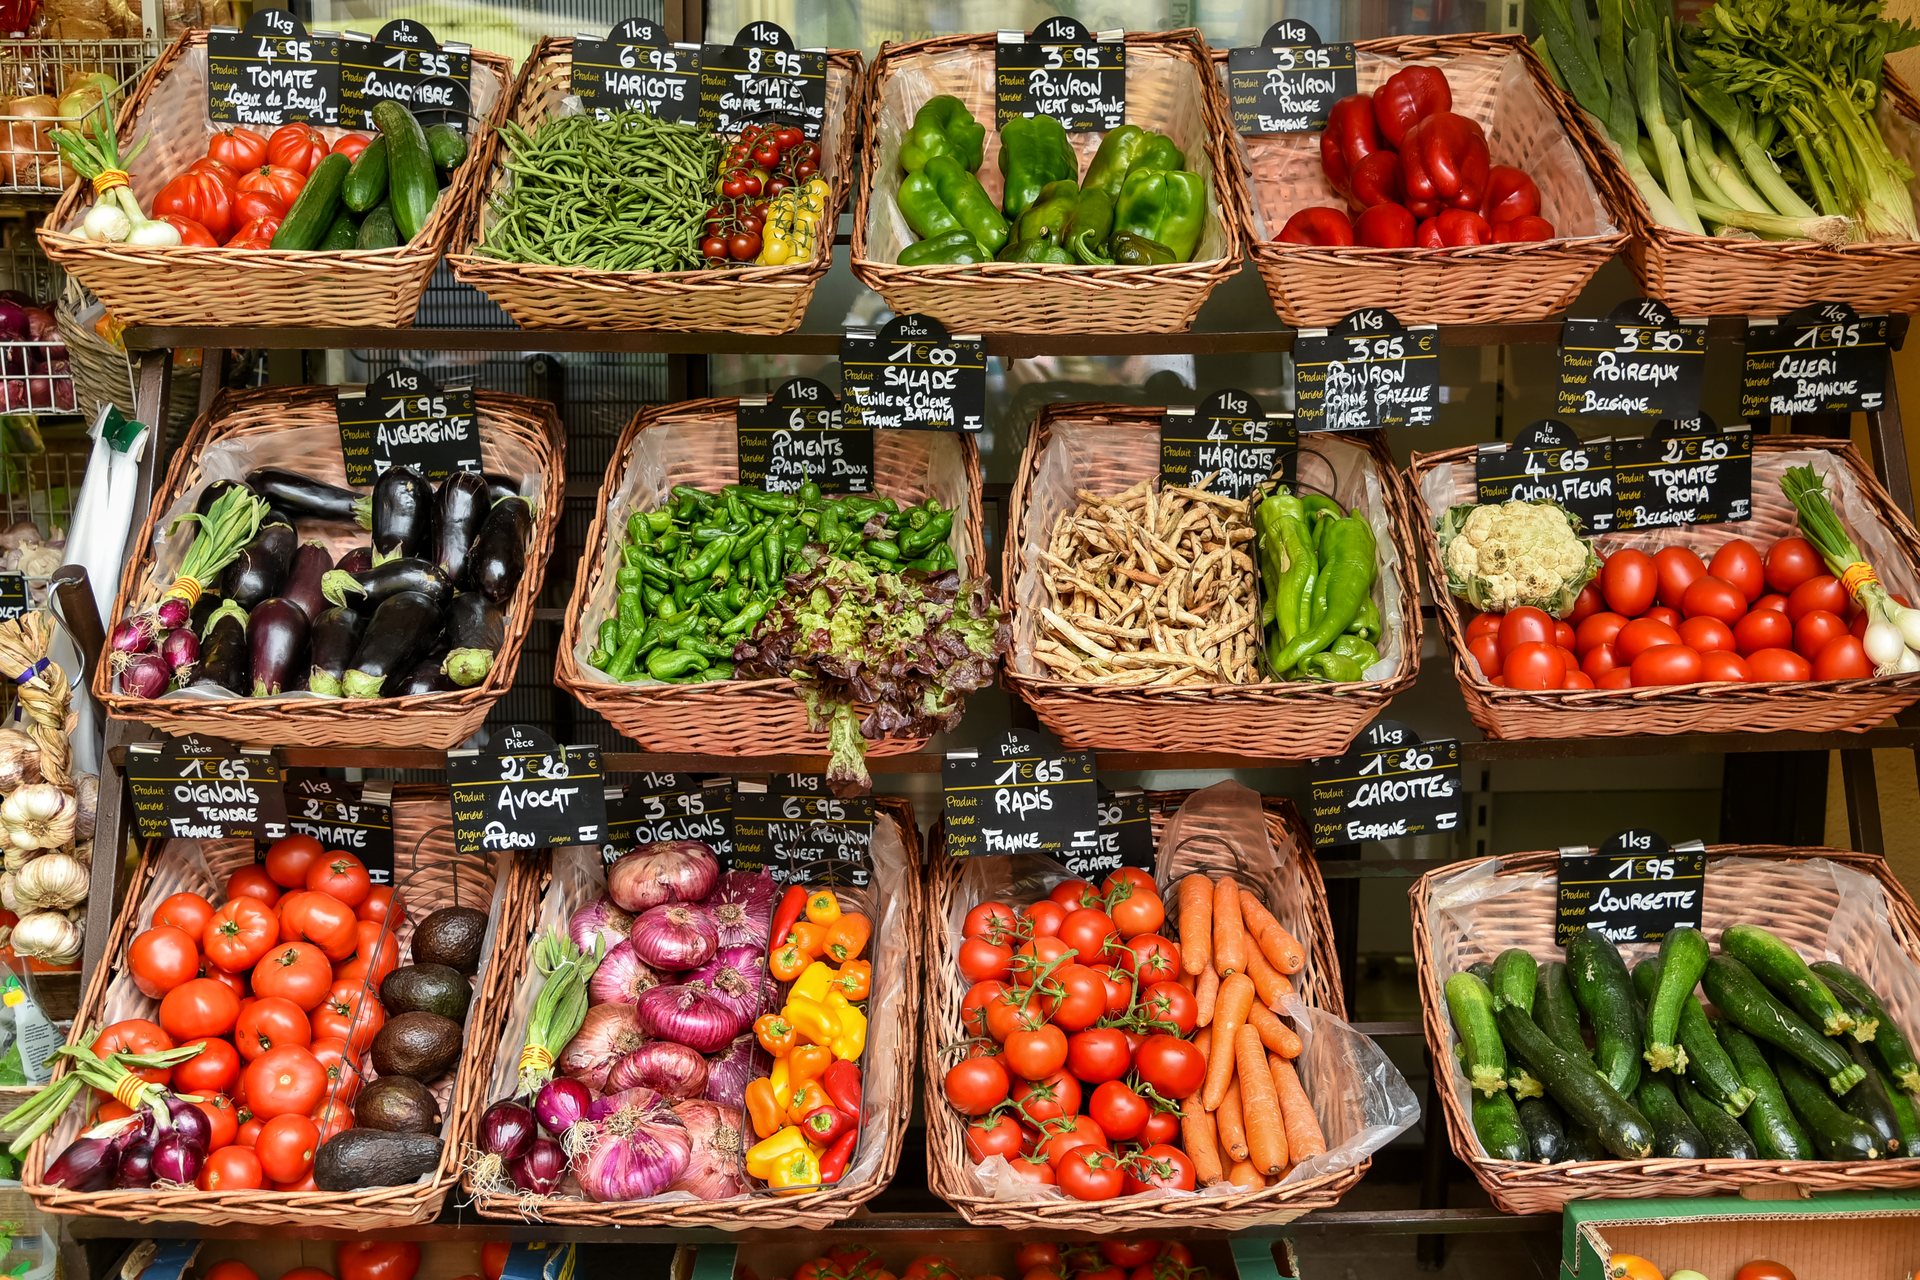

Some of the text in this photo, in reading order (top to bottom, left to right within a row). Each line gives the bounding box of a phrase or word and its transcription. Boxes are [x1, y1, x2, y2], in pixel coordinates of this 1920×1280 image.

[265, 11, 294, 35] 1kg
[401, 20, 410, 32] la
[622, 20, 652, 40] 1kg
[1046, 20, 1075, 40] 1kg
[1278, 22, 1306, 42] 1kg
[393, 30, 418, 43] Pièce
[751, 24, 779, 45] 1kg
[246, 66, 318, 89] TOMATE
[605, 71, 687, 101] HARICOTS
[734, 74, 808, 98] TOMATE
[1029, 69, 1102, 97] POIVRON
[1263, 69, 1336, 96] POIVRON
[360, 71, 454, 106] CONCOMBRE
[1036, 98, 1069, 114] VERT
[1085, 95, 1125, 118] JAUNE
[1279, 95, 1321, 113] ROUGE
[1257, 114, 1309, 132] ESPAGNE
[900, 325, 928, 336] Pièce
[909, 316, 918, 326] la
[1349, 310, 1383, 331] 1Kg
[1593, 351, 1680, 388] POIREAUX
[1773, 350, 1837, 379] CELERI
[387, 371, 418, 390] 1kg
[788, 381, 818, 400] 1kg
[883, 365, 960, 395] SALADE
[1794, 379, 1858, 402] BRANCHE
[1218, 392, 1248, 414] 1kg
[1580, 390, 1649, 415] BELGIQUE
[1769, 395, 1818, 416] FRANCE
[861, 410, 902, 429] FRANCE
[903, 406, 955, 426] BATAVIA
[376, 416, 470, 457] AUBERGINE
[1545, 421, 1553, 433] la
[772, 430, 844, 457] PIMENTS
[1534, 431, 1560, 445] Pièce
[832, 458, 868, 476] DOUX
[1198, 443, 1276, 470] HARICOTS
[1648, 464, 1719, 487] TOMATE
[1666, 485, 1709, 504] ROMA
[1633, 505, 1696, 528] BELGIQUE
[188, 736, 199, 745] la
[511, 727, 522, 738] la
[1008, 732, 1018, 743] la
[1369, 724, 1403, 744] 1kg
[182, 744, 213, 754] Pièce
[505, 738, 535, 749] Pièce
[1000, 743, 1030, 756] Pièce
[300, 780, 332, 794] 1kg
[643, 772, 676, 789] 1kg
[787, 773, 818, 791] 1kg
[1347, 774, 1454, 808] CAROTTES
[174, 780, 260, 804] OIGNONS
[497, 784, 579, 820] AVOCAT
[197, 806, 258, 822] TENDRE
[995, 786, 1053, 821] RADIS
[170, 818, 224, 839] FRANCE
[290, 822, 367, 848] TOMATE
[482, 820, 536, 849] PEROU
[635, 814, 725, 843] OIGNONS
[1347, 819, 1407, 841] ESPAGNE
[982, 828, 1042, 853] FRANCE
[1619, 831, 1651, 849] 1kg
[1589, 887, 1696, 912] COURGETTE
